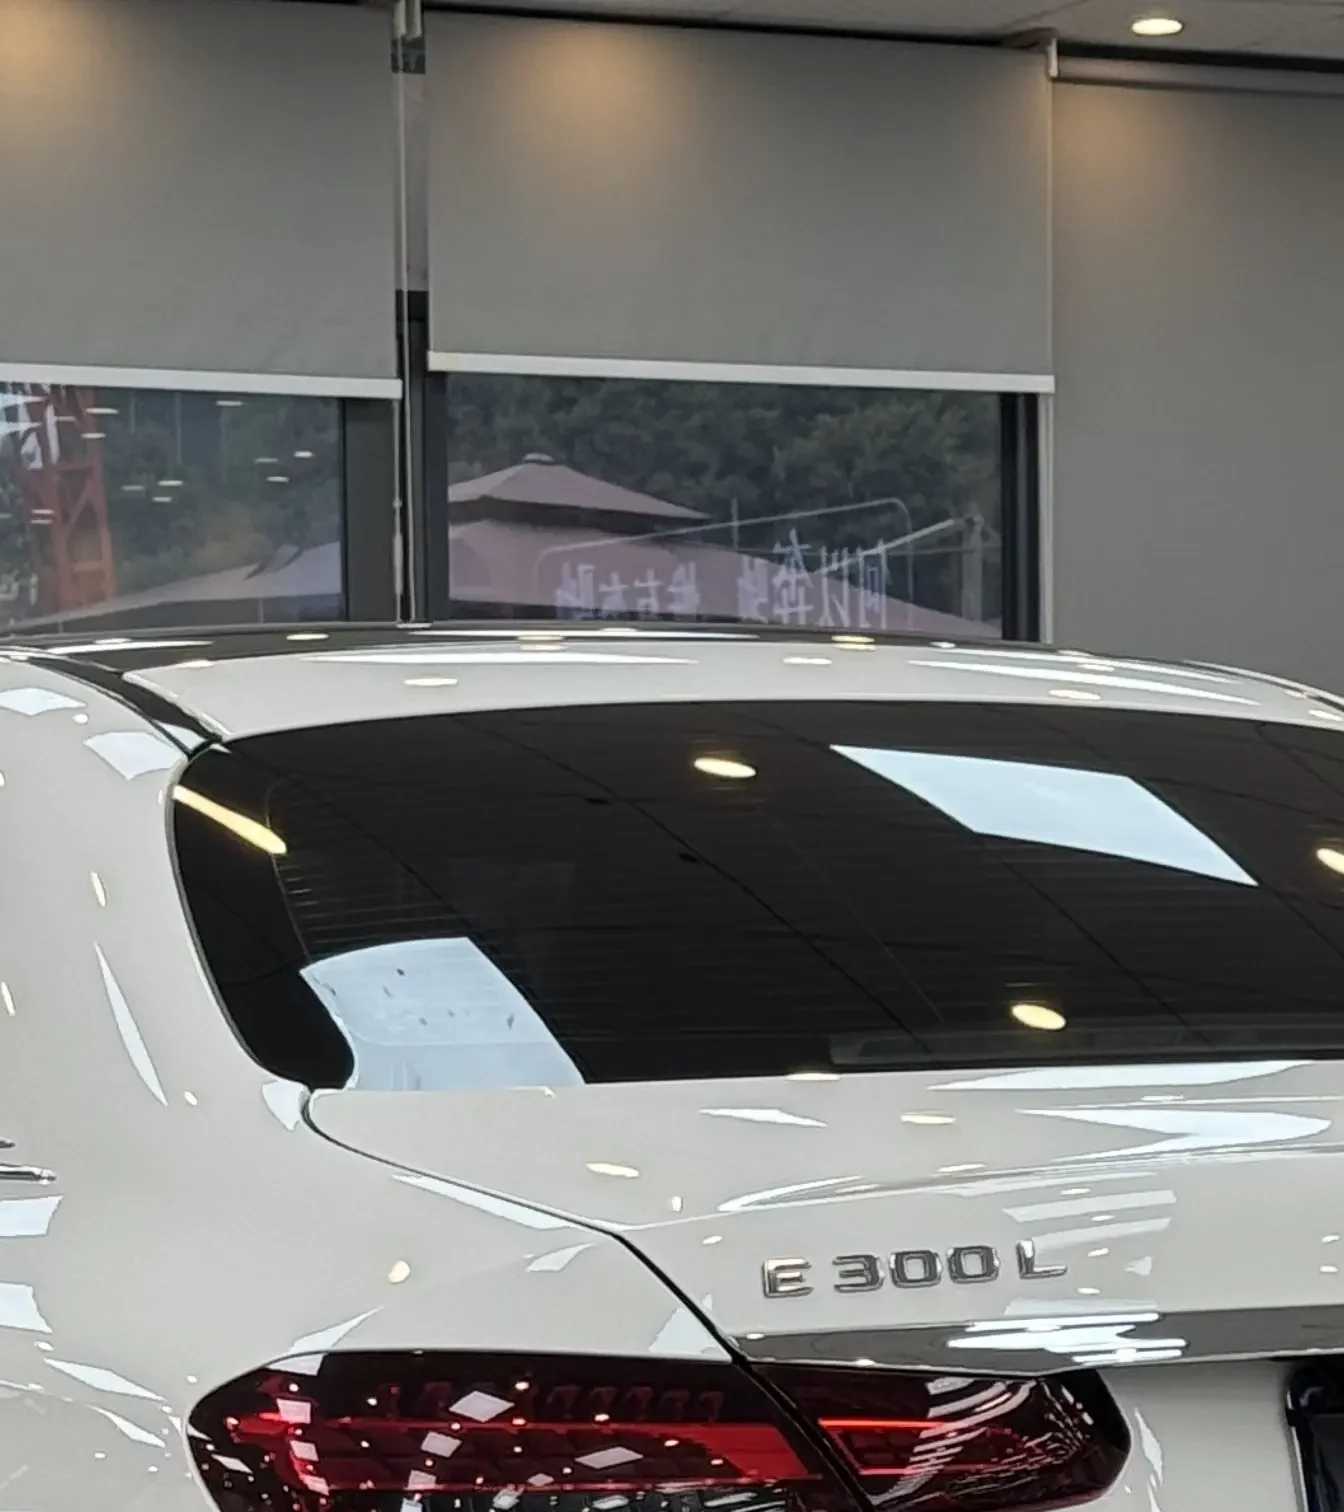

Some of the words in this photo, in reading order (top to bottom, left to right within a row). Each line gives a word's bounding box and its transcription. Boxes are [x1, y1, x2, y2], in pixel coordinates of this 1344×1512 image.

[761, 1257, 814, 1298] E
[831, 1245, 1001, 1294] 300
[1015, 1238, 1069, 1280] L
